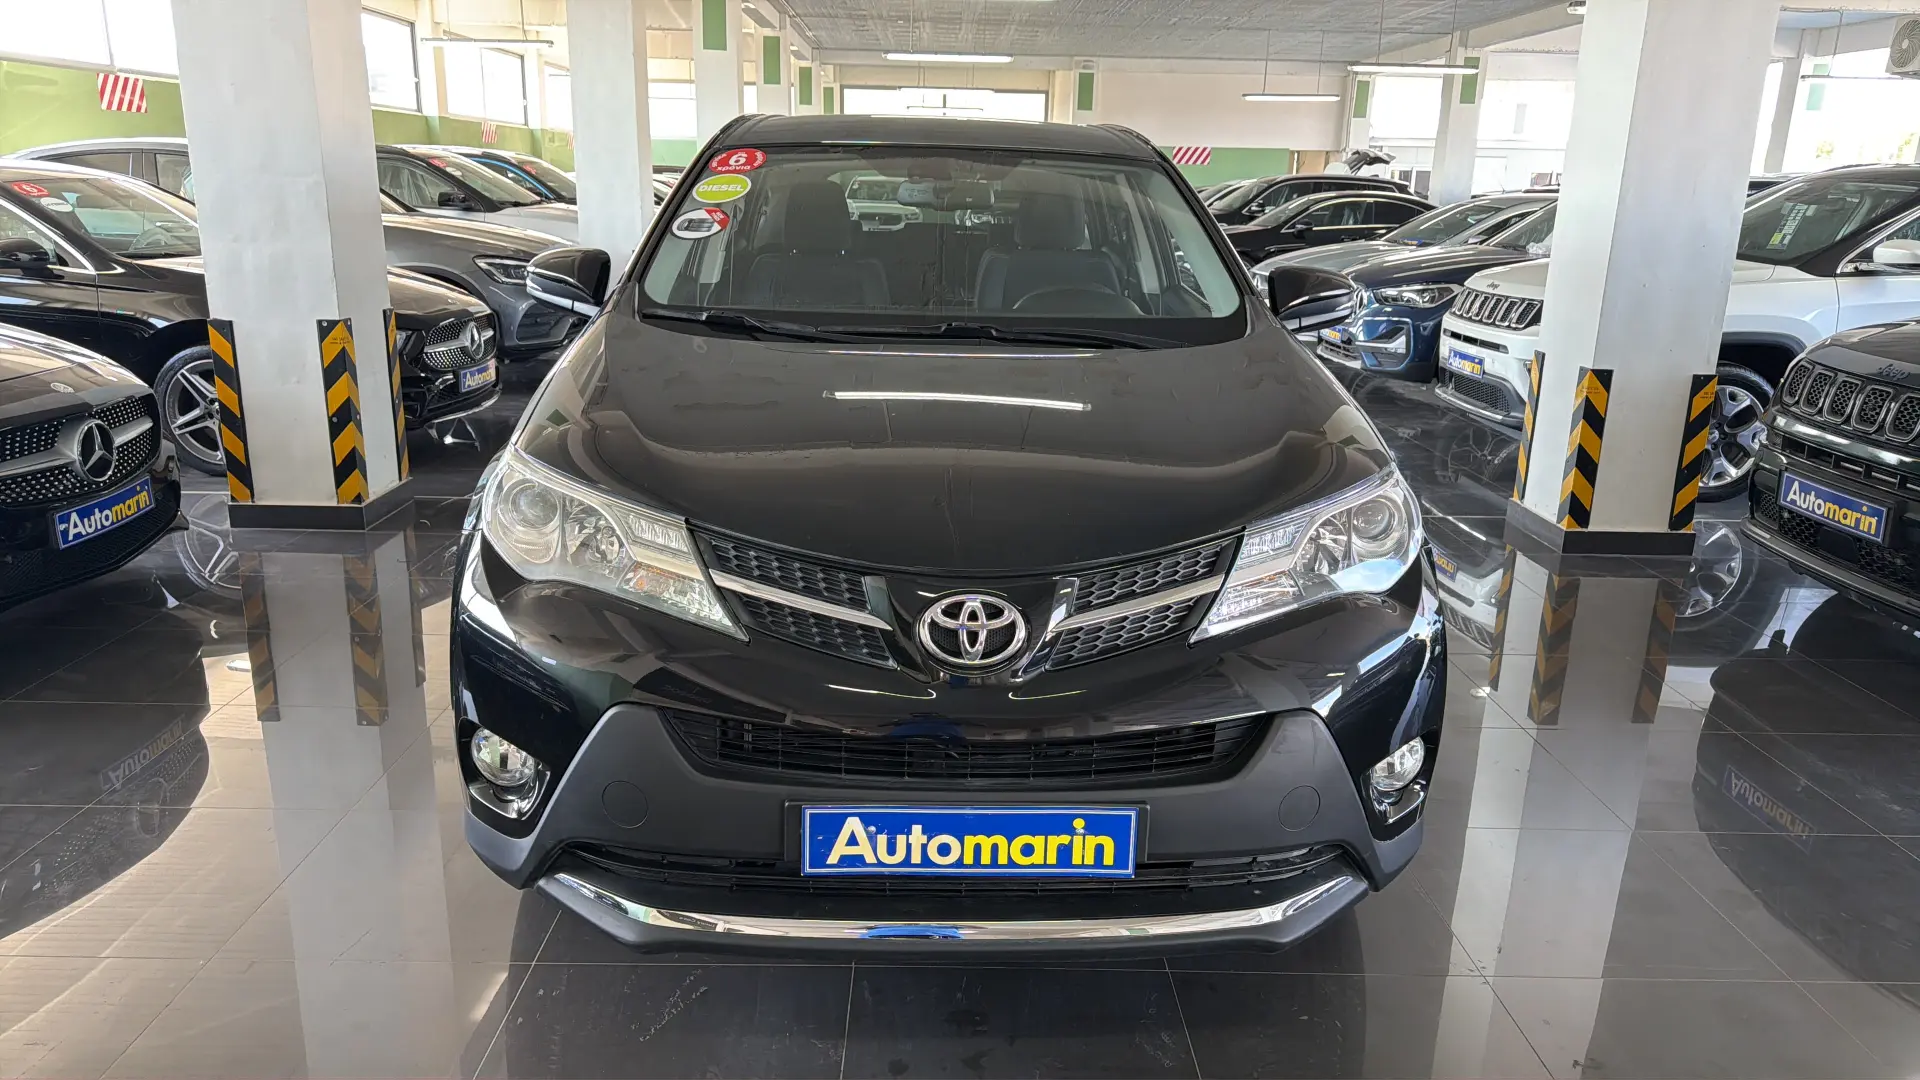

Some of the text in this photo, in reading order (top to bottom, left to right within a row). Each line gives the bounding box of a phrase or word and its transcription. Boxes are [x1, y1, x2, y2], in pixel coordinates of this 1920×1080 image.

[729, 153, 748, 166] 6
[698, 184, 744, 192] DIESEL
[1876, 363, 1911, 381] Jeep
[68, 485, 150, 541] Automarin
[1787, 480, 1877, 535] Automarin
[826, 816, 1114, 866] Automarin
